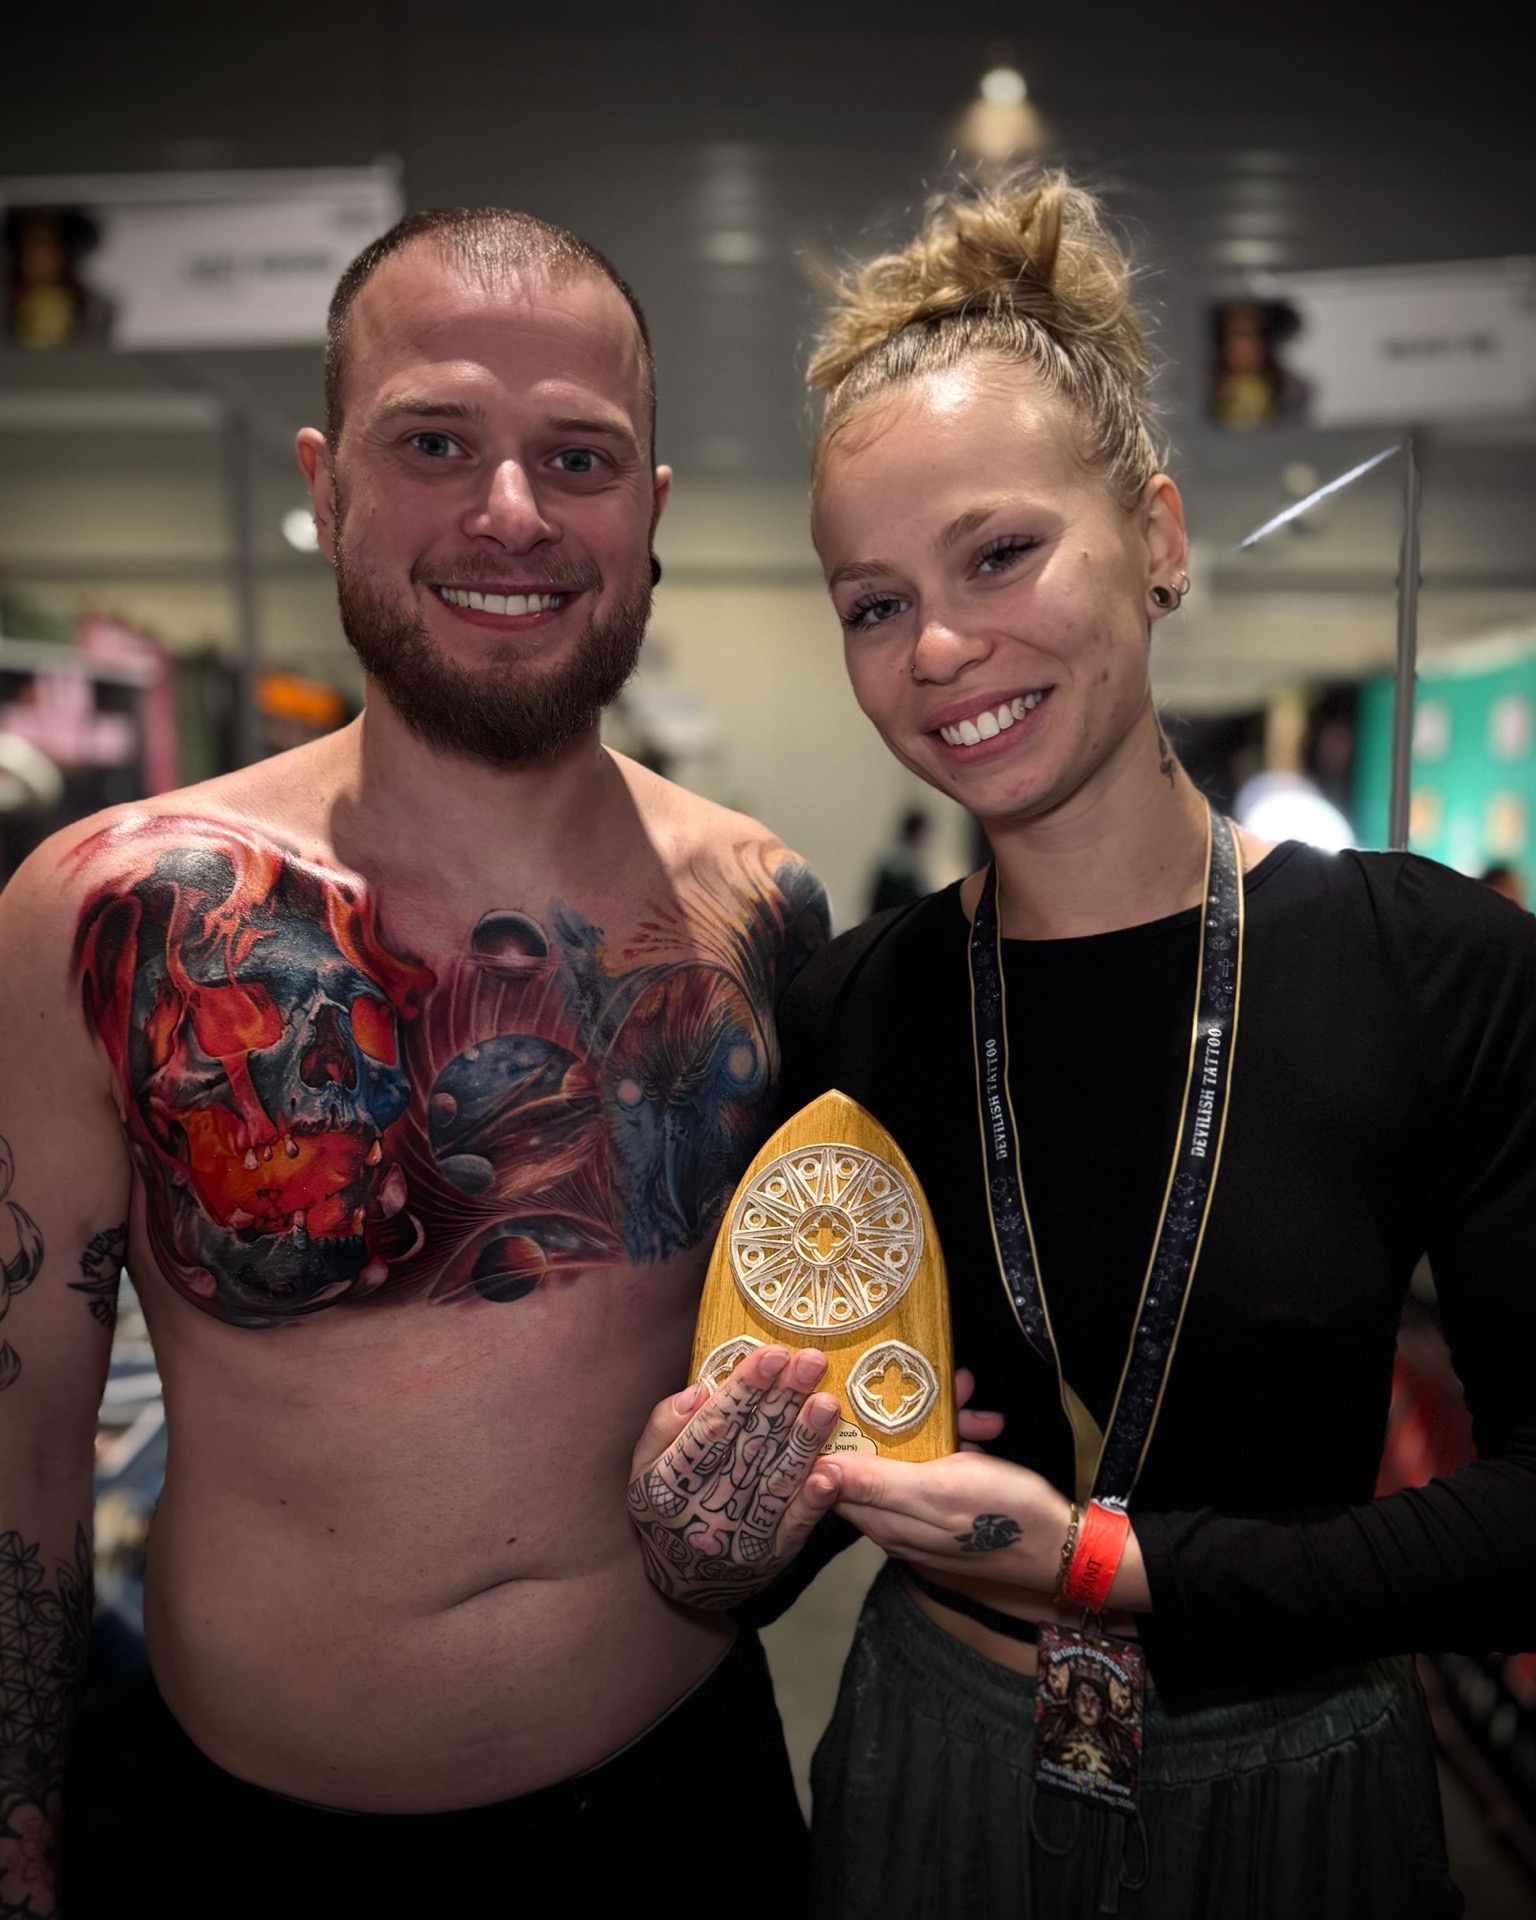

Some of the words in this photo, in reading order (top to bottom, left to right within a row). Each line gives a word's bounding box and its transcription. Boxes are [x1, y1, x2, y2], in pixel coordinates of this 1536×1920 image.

[985, 1038, 998, 1094] TATTOO
[1202, 1028, 1222, 1085] TATTOO
[988, 1094, 1008, 1160] DEVILISH
[1190, 1088, 1215, 1158] DEVILISH
[824, 1443, 833, 1451] (2
[834, 1442, 858, 1453] jours)
[838, 1429, 858, 1437] 2026
[1050, 1645, 1083, 1662] Artiste
[1084, 1647, 1129, 1683] exposant
